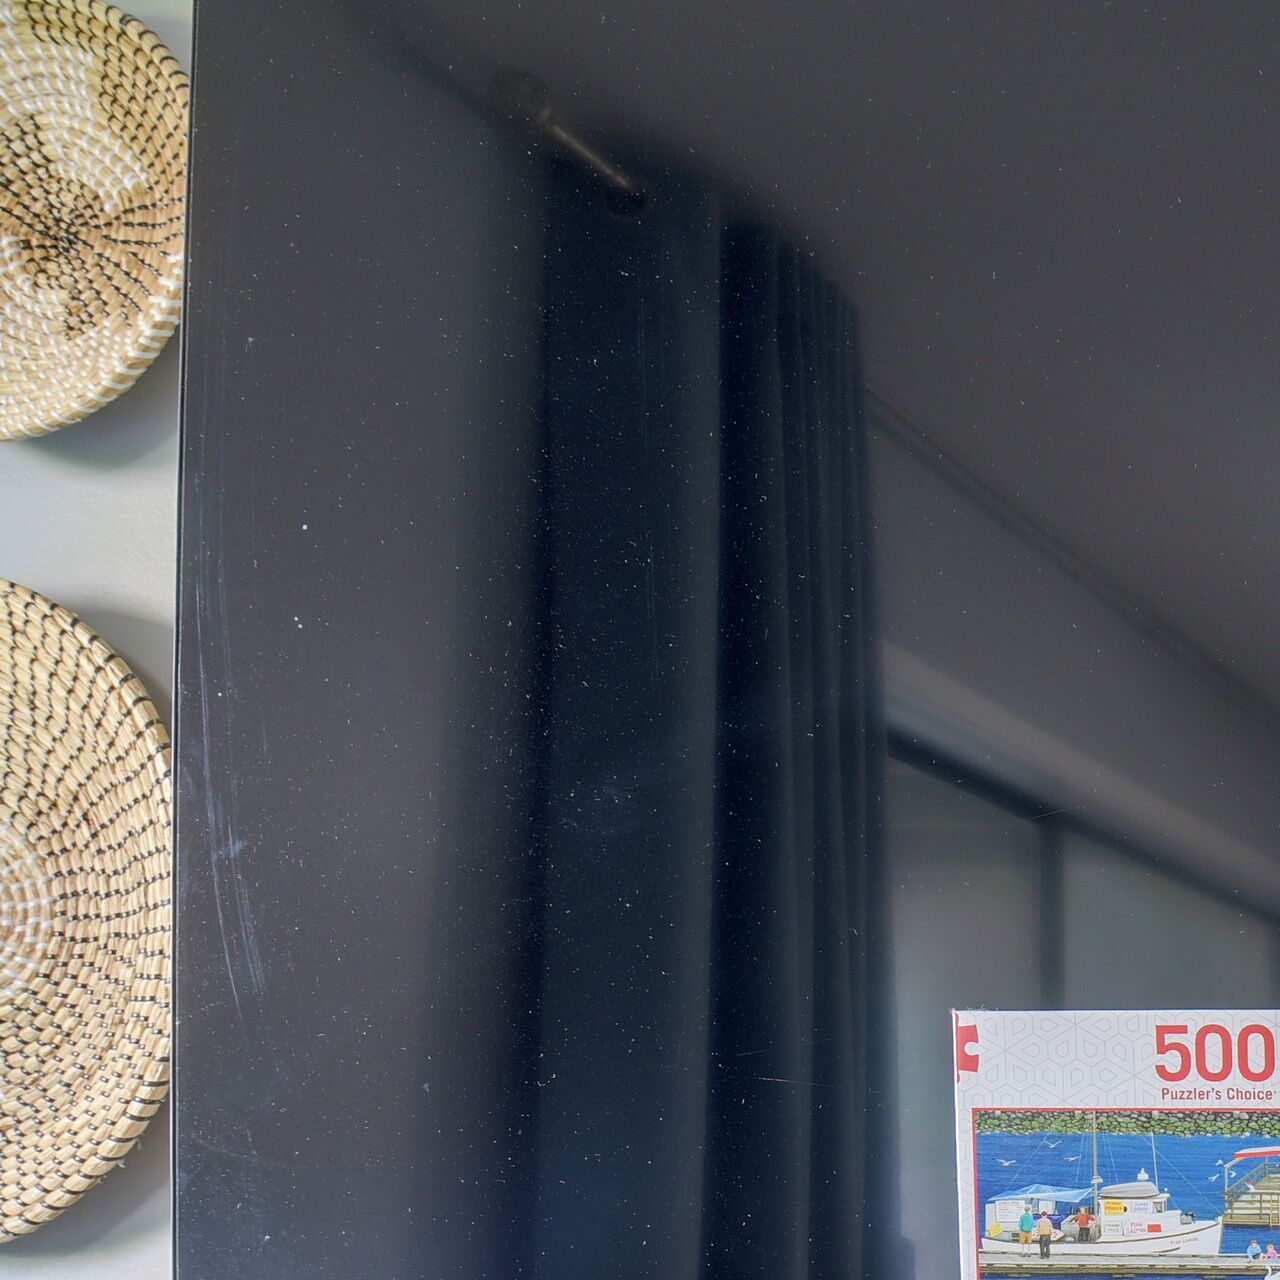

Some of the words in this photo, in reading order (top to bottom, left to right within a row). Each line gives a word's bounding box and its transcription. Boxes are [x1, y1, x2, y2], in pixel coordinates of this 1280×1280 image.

[1155, 1024, 1275, 1082] 500
[1162, 1088, 1221, 1100] Puzzler's
[1227, 1088, 1272, 1100] Choice
